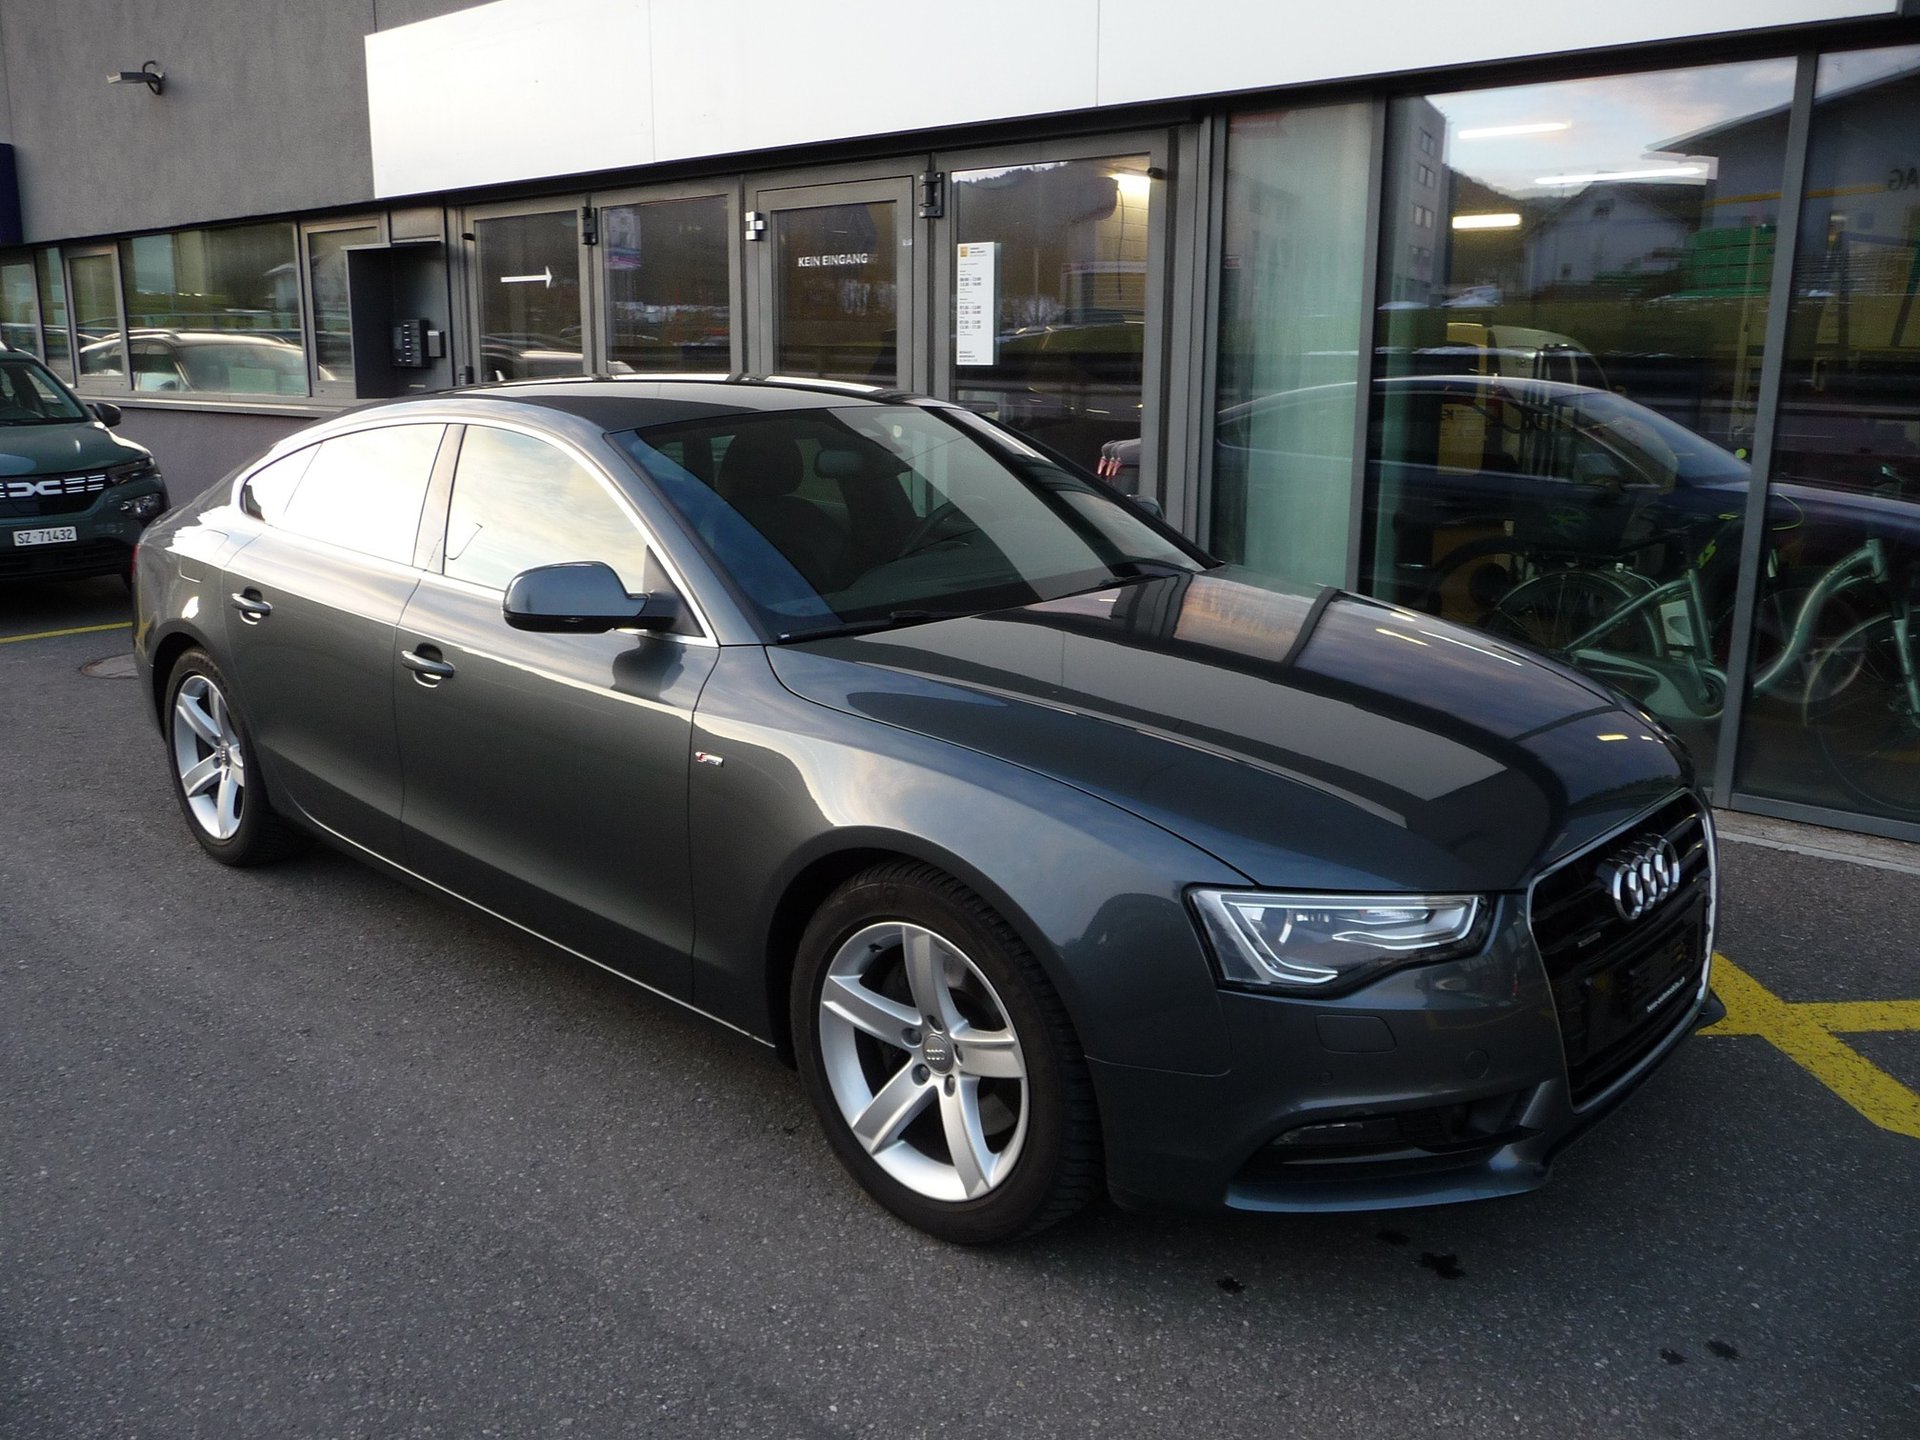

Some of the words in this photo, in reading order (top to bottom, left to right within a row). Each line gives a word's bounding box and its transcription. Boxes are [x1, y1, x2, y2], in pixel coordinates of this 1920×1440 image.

[797, 255, 820, 267] KEIN
[822, 252, 868, 266] EINGANG
[39, 528, 73, 542] 71432
